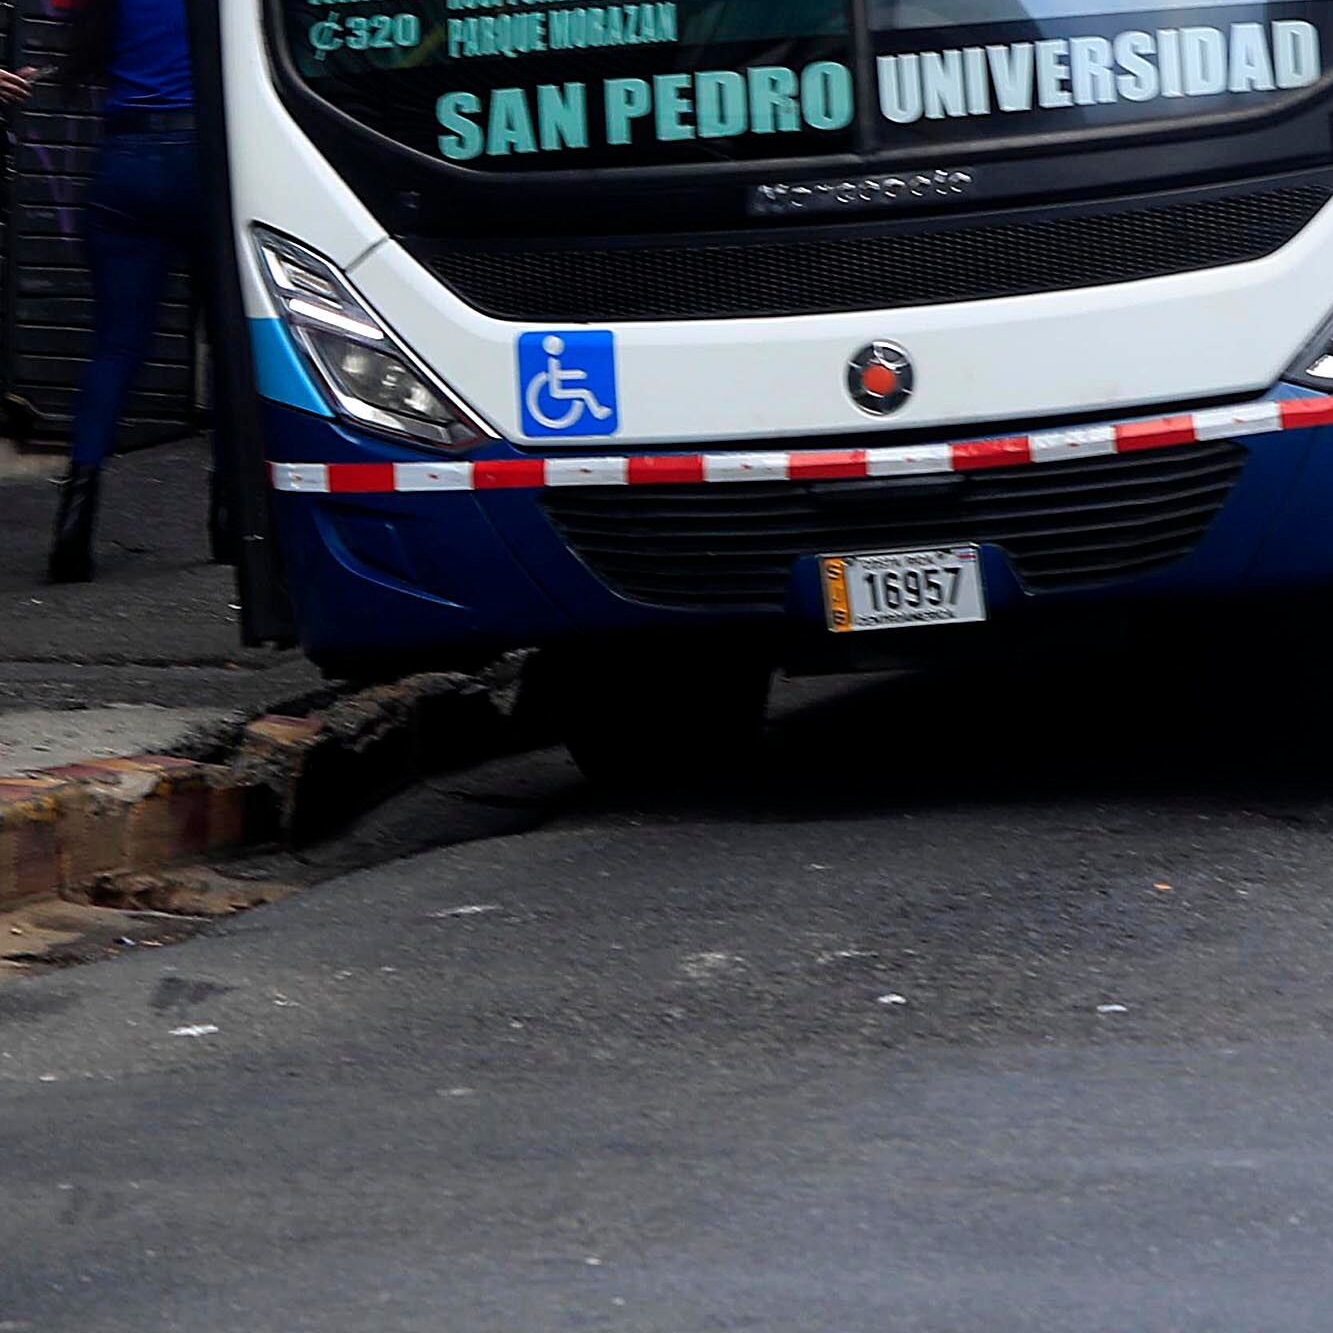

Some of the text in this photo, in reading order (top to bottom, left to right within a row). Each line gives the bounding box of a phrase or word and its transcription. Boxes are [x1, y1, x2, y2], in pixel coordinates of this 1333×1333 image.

[447, 11, 549, 59] PARQUE
[876, 19, 1322, 124] UNIVERSIDAD
[435, 60, 856, 162] SAN PEDRO
[863, 566, 964, 613] 16957
